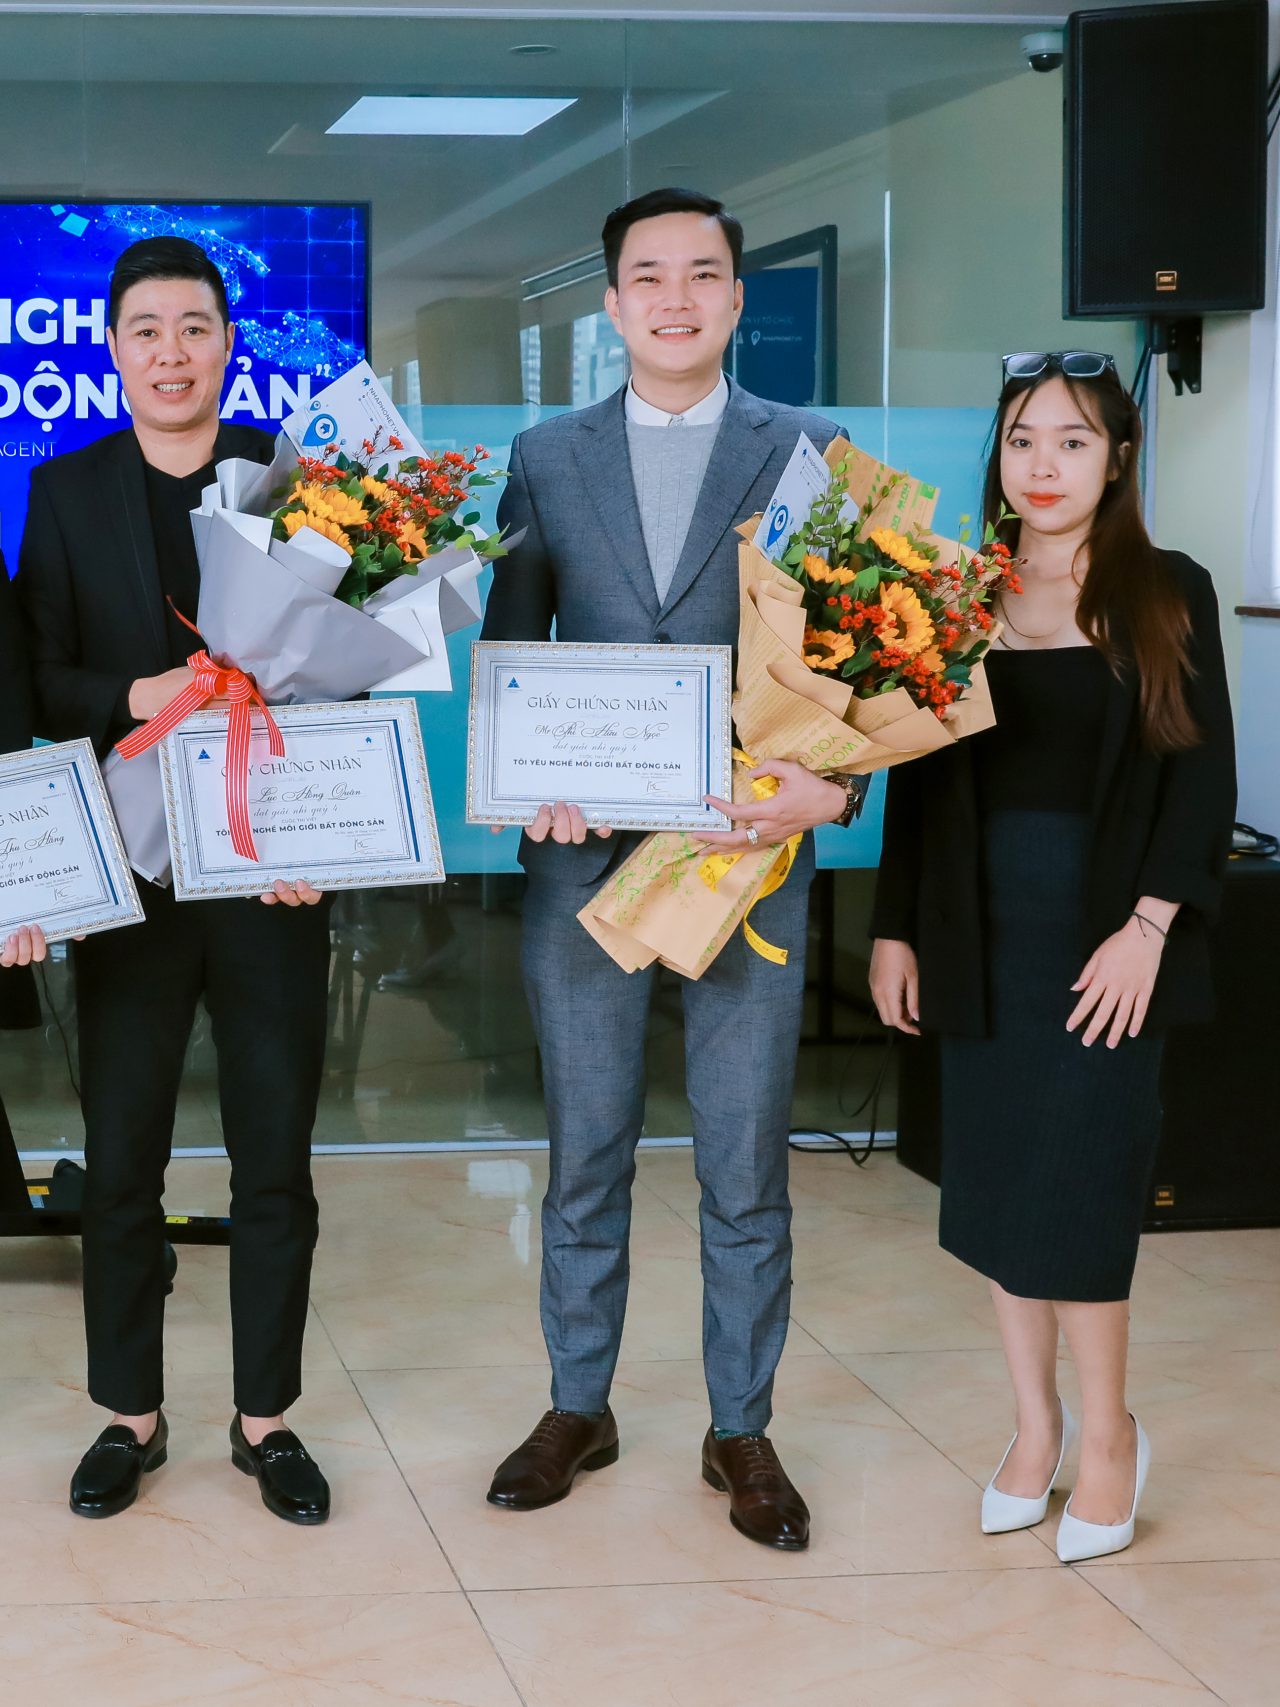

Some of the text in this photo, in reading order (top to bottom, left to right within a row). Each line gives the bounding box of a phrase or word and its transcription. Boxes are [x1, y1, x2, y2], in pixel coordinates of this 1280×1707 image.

[527, 691, 668, 712] GIẤY CHỨNG NHẬN
[810, 733, 840, 757] YOU
[819, 741, 857, 769] WOUL
[259, 758, 315, 775] CHỨNG
[319, 755, 362, 772] NHẬN
[513, 758, 681, 770] TÔI YÊU NGHỀ MÔI GIỚI BẤT ĐỘNG SẢN
[797, 752, 814, 766] FO
[8, 804, 50, 824] NHẬN
[252, 825, 276, 834] NGHỀ
[280, 824, 296, 832] MÔI
[298, 822, 317, 831] GIỚI
[320, 821, 336, 830] BẤT
[367, 817, 385, 826] SẢN
[0, 879, 17, 888] GIỚI
[18, 874, 34, 884] BẤT
[37, 869, 61, 880] ĐỘNG
[62, 864, 80, 874] SẢN
